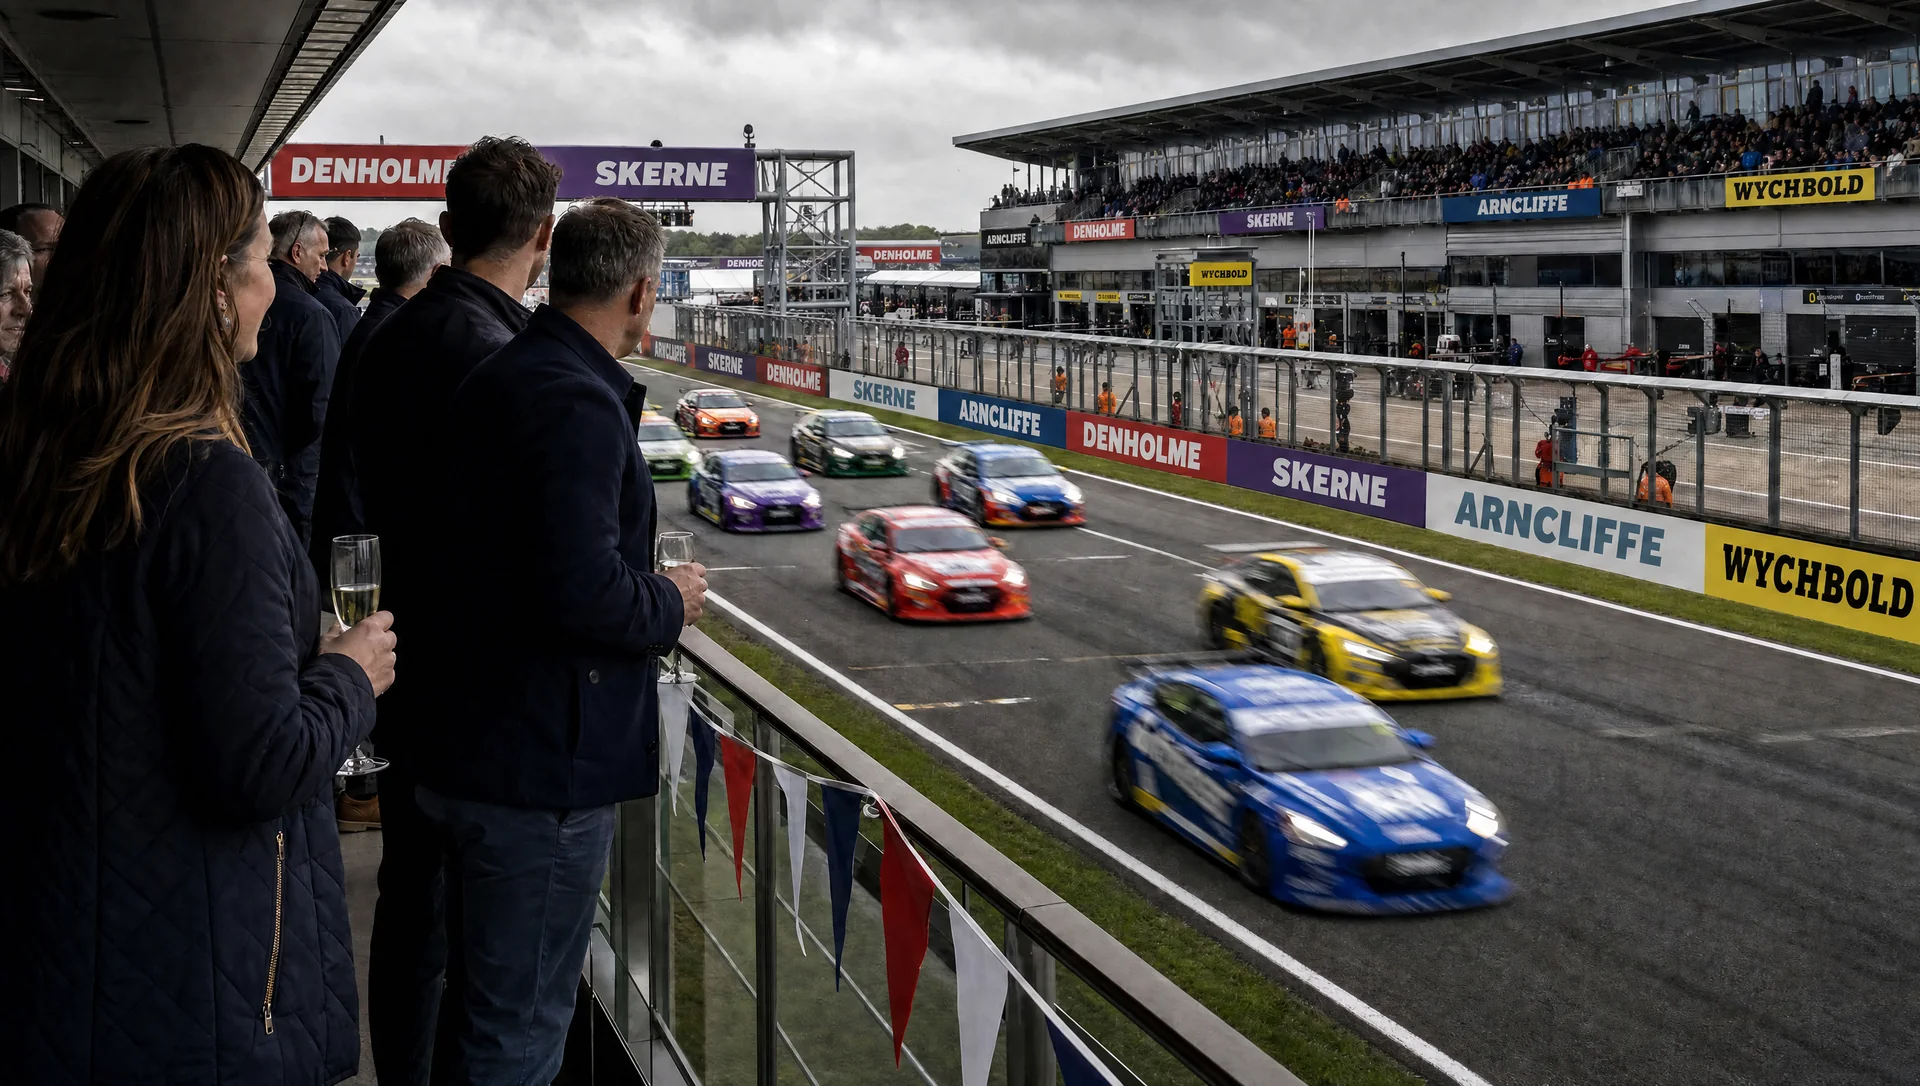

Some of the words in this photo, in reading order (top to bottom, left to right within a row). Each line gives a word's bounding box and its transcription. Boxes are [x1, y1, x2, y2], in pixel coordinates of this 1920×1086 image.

[291, 157, 456, 184] DENHOLME
[595, 161, 728, 187] SKERNE
[1734, 174, 1864, 200] WYCHBOLD
[1478, 195, 1568, 215] ARNCLIFFE
[1074, 222, 1126, 239] DENHOLME
[1247, 211, 1294, 229] SKERNE
[986, 232, 1027, 245] ARNCLIFFE
[873, 250, 933, 261] DENHOLME
[1201, 269, 1248, 280] WYCHBOLD
[709, 352, 743, 375] SKERNE
[767, 363, 822, 391] DENHOLME
[854, 380, 916, 411] SKERNE
[958, 399, 1042, 437] ARNCLIFFE
[1083, 421, 1202, 471] DENHOLME
[1272, 457, 1388, 507] SKERNE
[1455, 491, 1666, 567] ARNCLIFFE
[1722, 543, 1915, 618] WYCHBOLD
